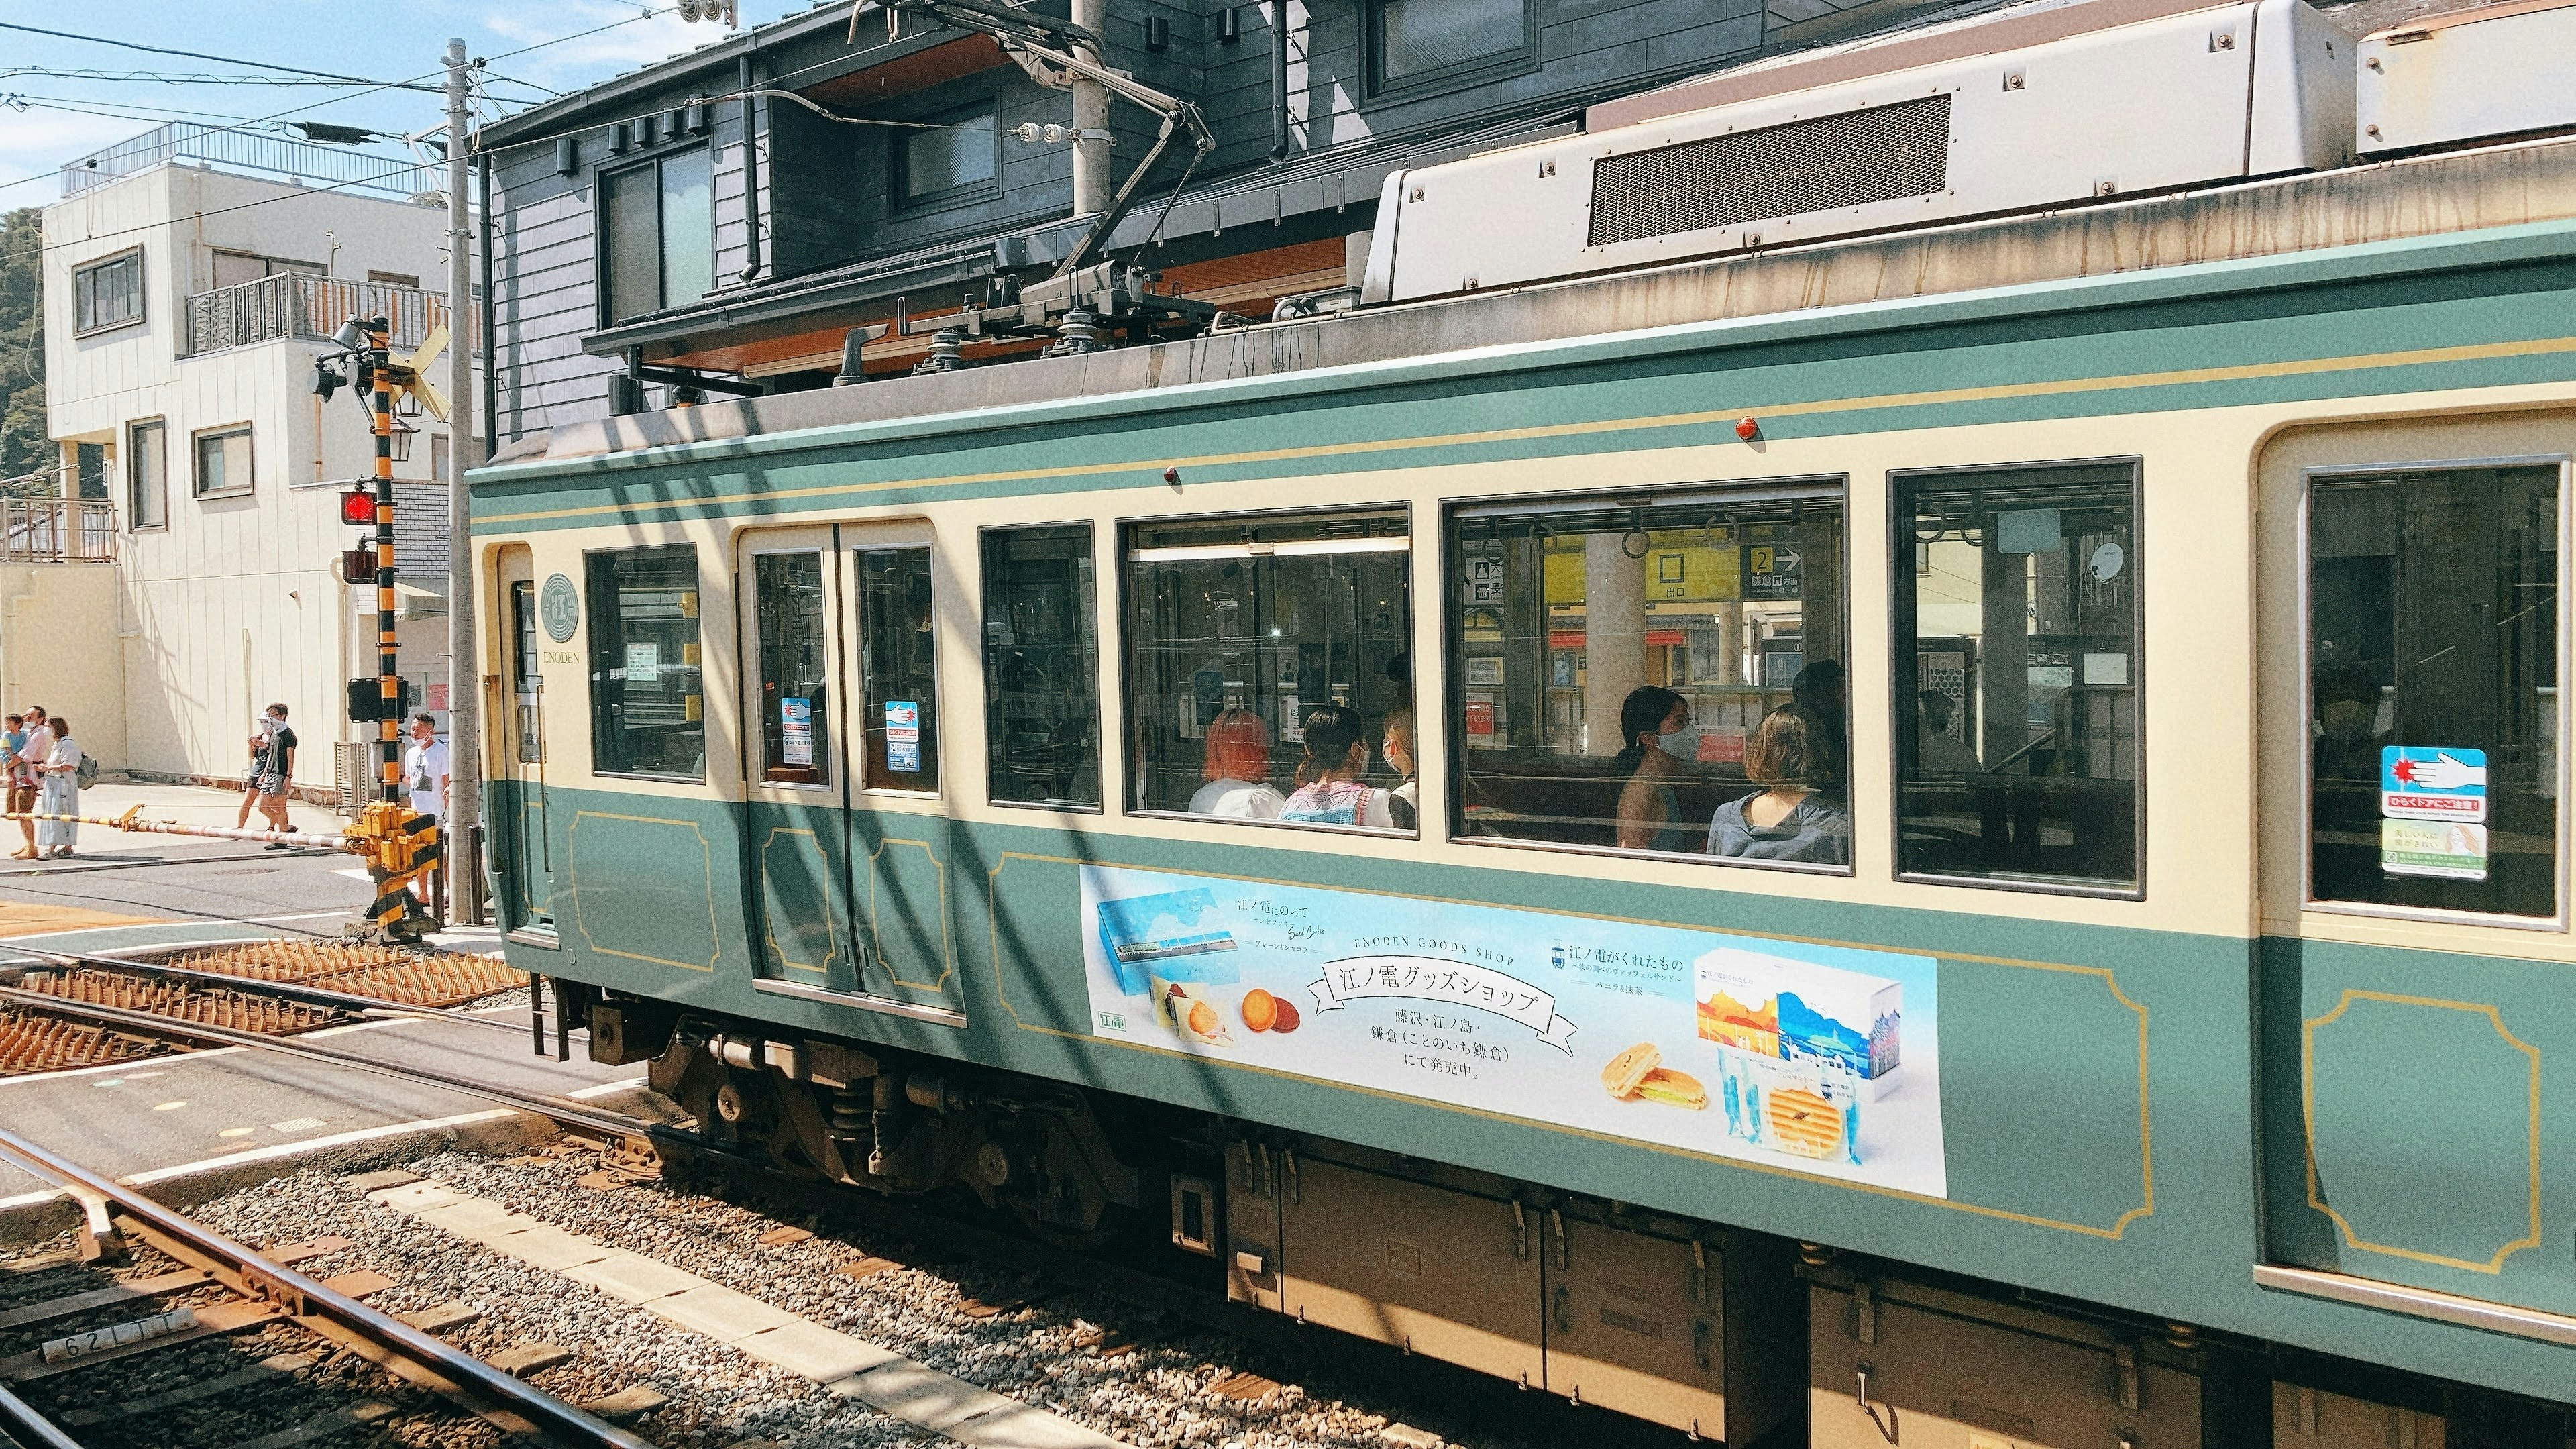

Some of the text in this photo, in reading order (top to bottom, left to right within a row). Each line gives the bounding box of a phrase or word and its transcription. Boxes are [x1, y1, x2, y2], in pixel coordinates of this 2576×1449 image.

[1756, 551, 1767, 570] 2
[1666, 588, 1684, 598] 出口
[543, 651, 580, 664] ENODEN
[1238, 898, 1307, 918] 江ノ電にのって
[1354, 936, 1514, 966] ENODEN GOODS SHOP
[1569, 945, 1684, 971] 江ノ電がくれたもの
[1339, 964, 1539, 1010] 江ノ電グッズショップ
[1404, 1053, 1479, 1079] にて発売中。
